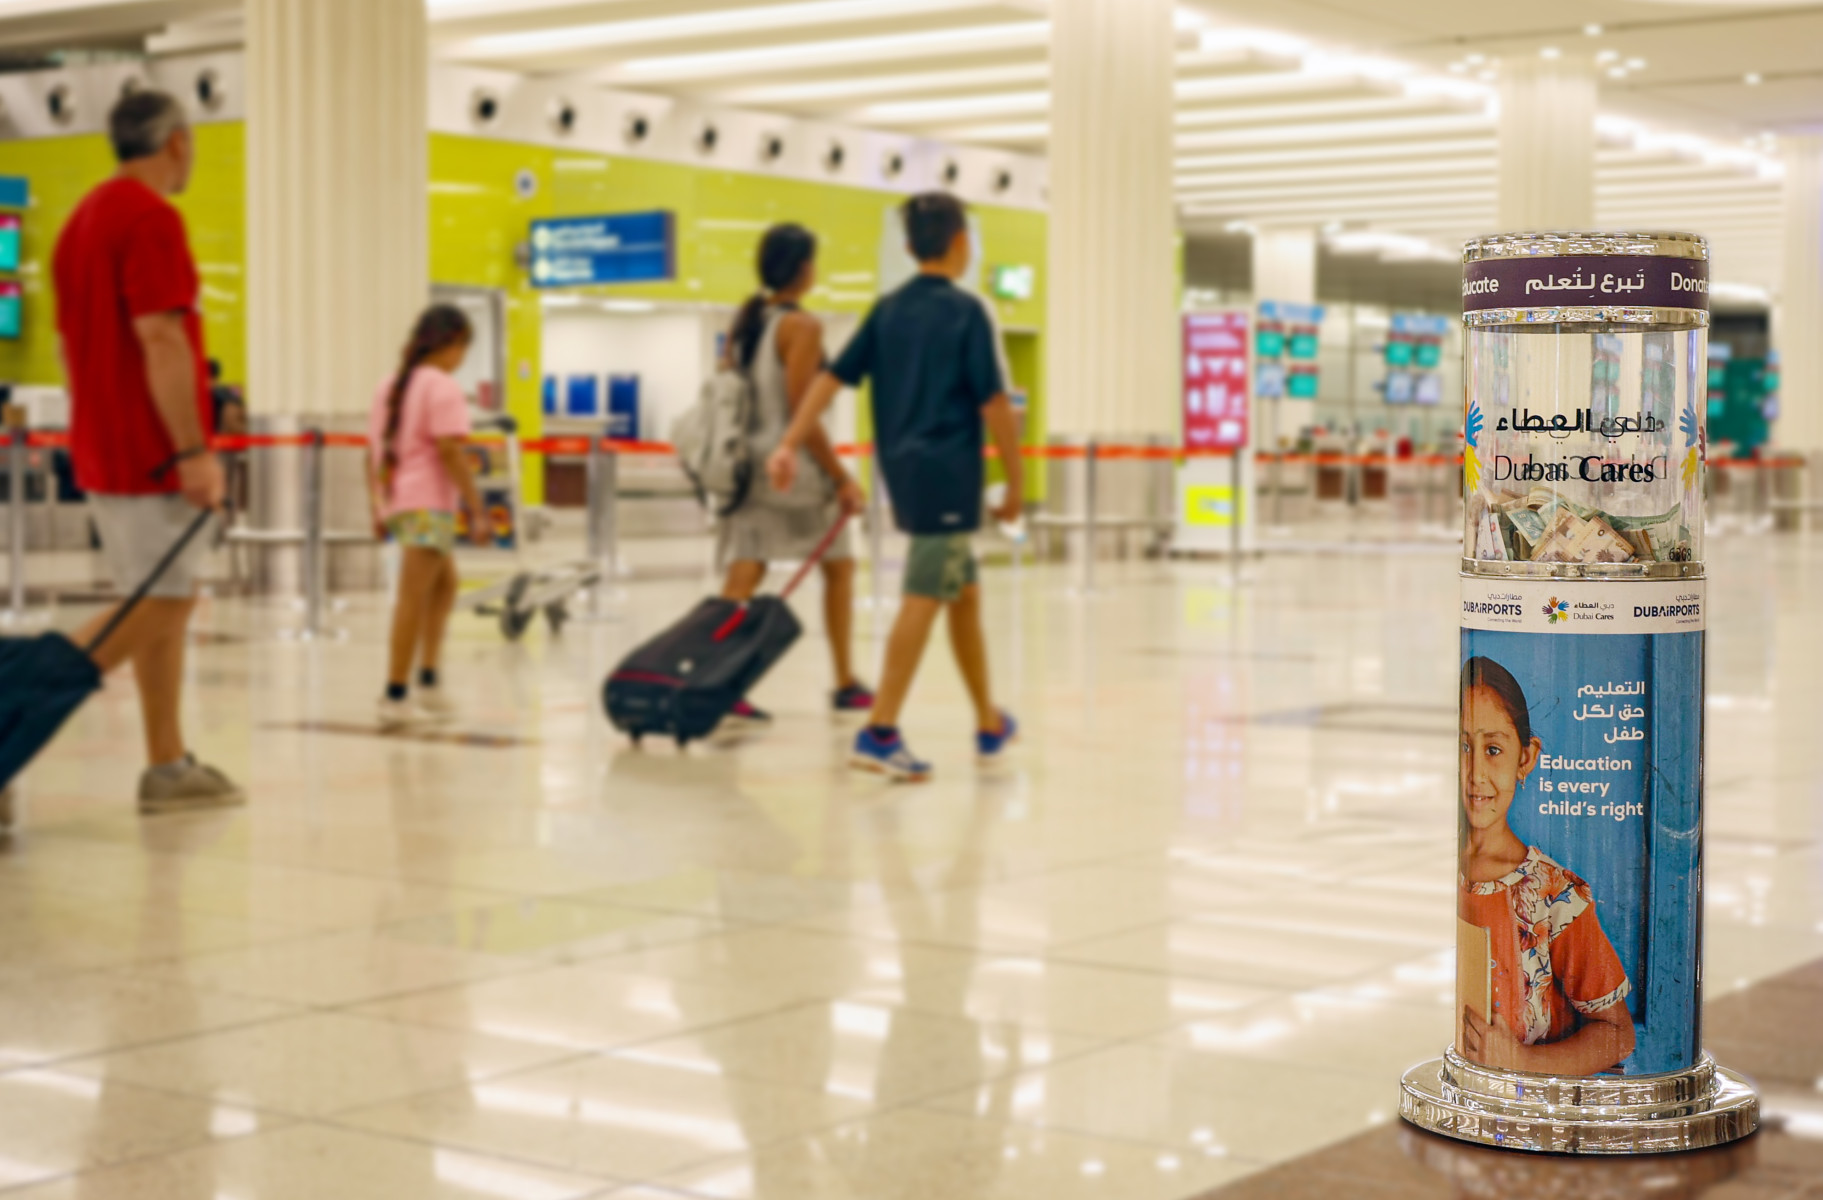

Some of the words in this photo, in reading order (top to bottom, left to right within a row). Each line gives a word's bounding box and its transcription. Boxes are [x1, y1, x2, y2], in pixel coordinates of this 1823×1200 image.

[1496, 408, 1591, 432] العطاء
[1494, 453, 1567, 482] Dubai
[1578, 455, 1655, 483] Cares
[1573, 612, 1594, 620] Dubai
[1595, 612, 1614, 620] Cares
[1577, 681, 1645, 698] التعليم
[1572, 704, 1614, 721] لكل
[1618, 704, 1645, 721] حق
[1604, 726, 1645, 744] طفل
[1540, 754, 1632, 771] Education
[1540, 777, 1554, 792] is
[1557, 781, 1610, 797] every
[1601, 801, 1644, 821] right
